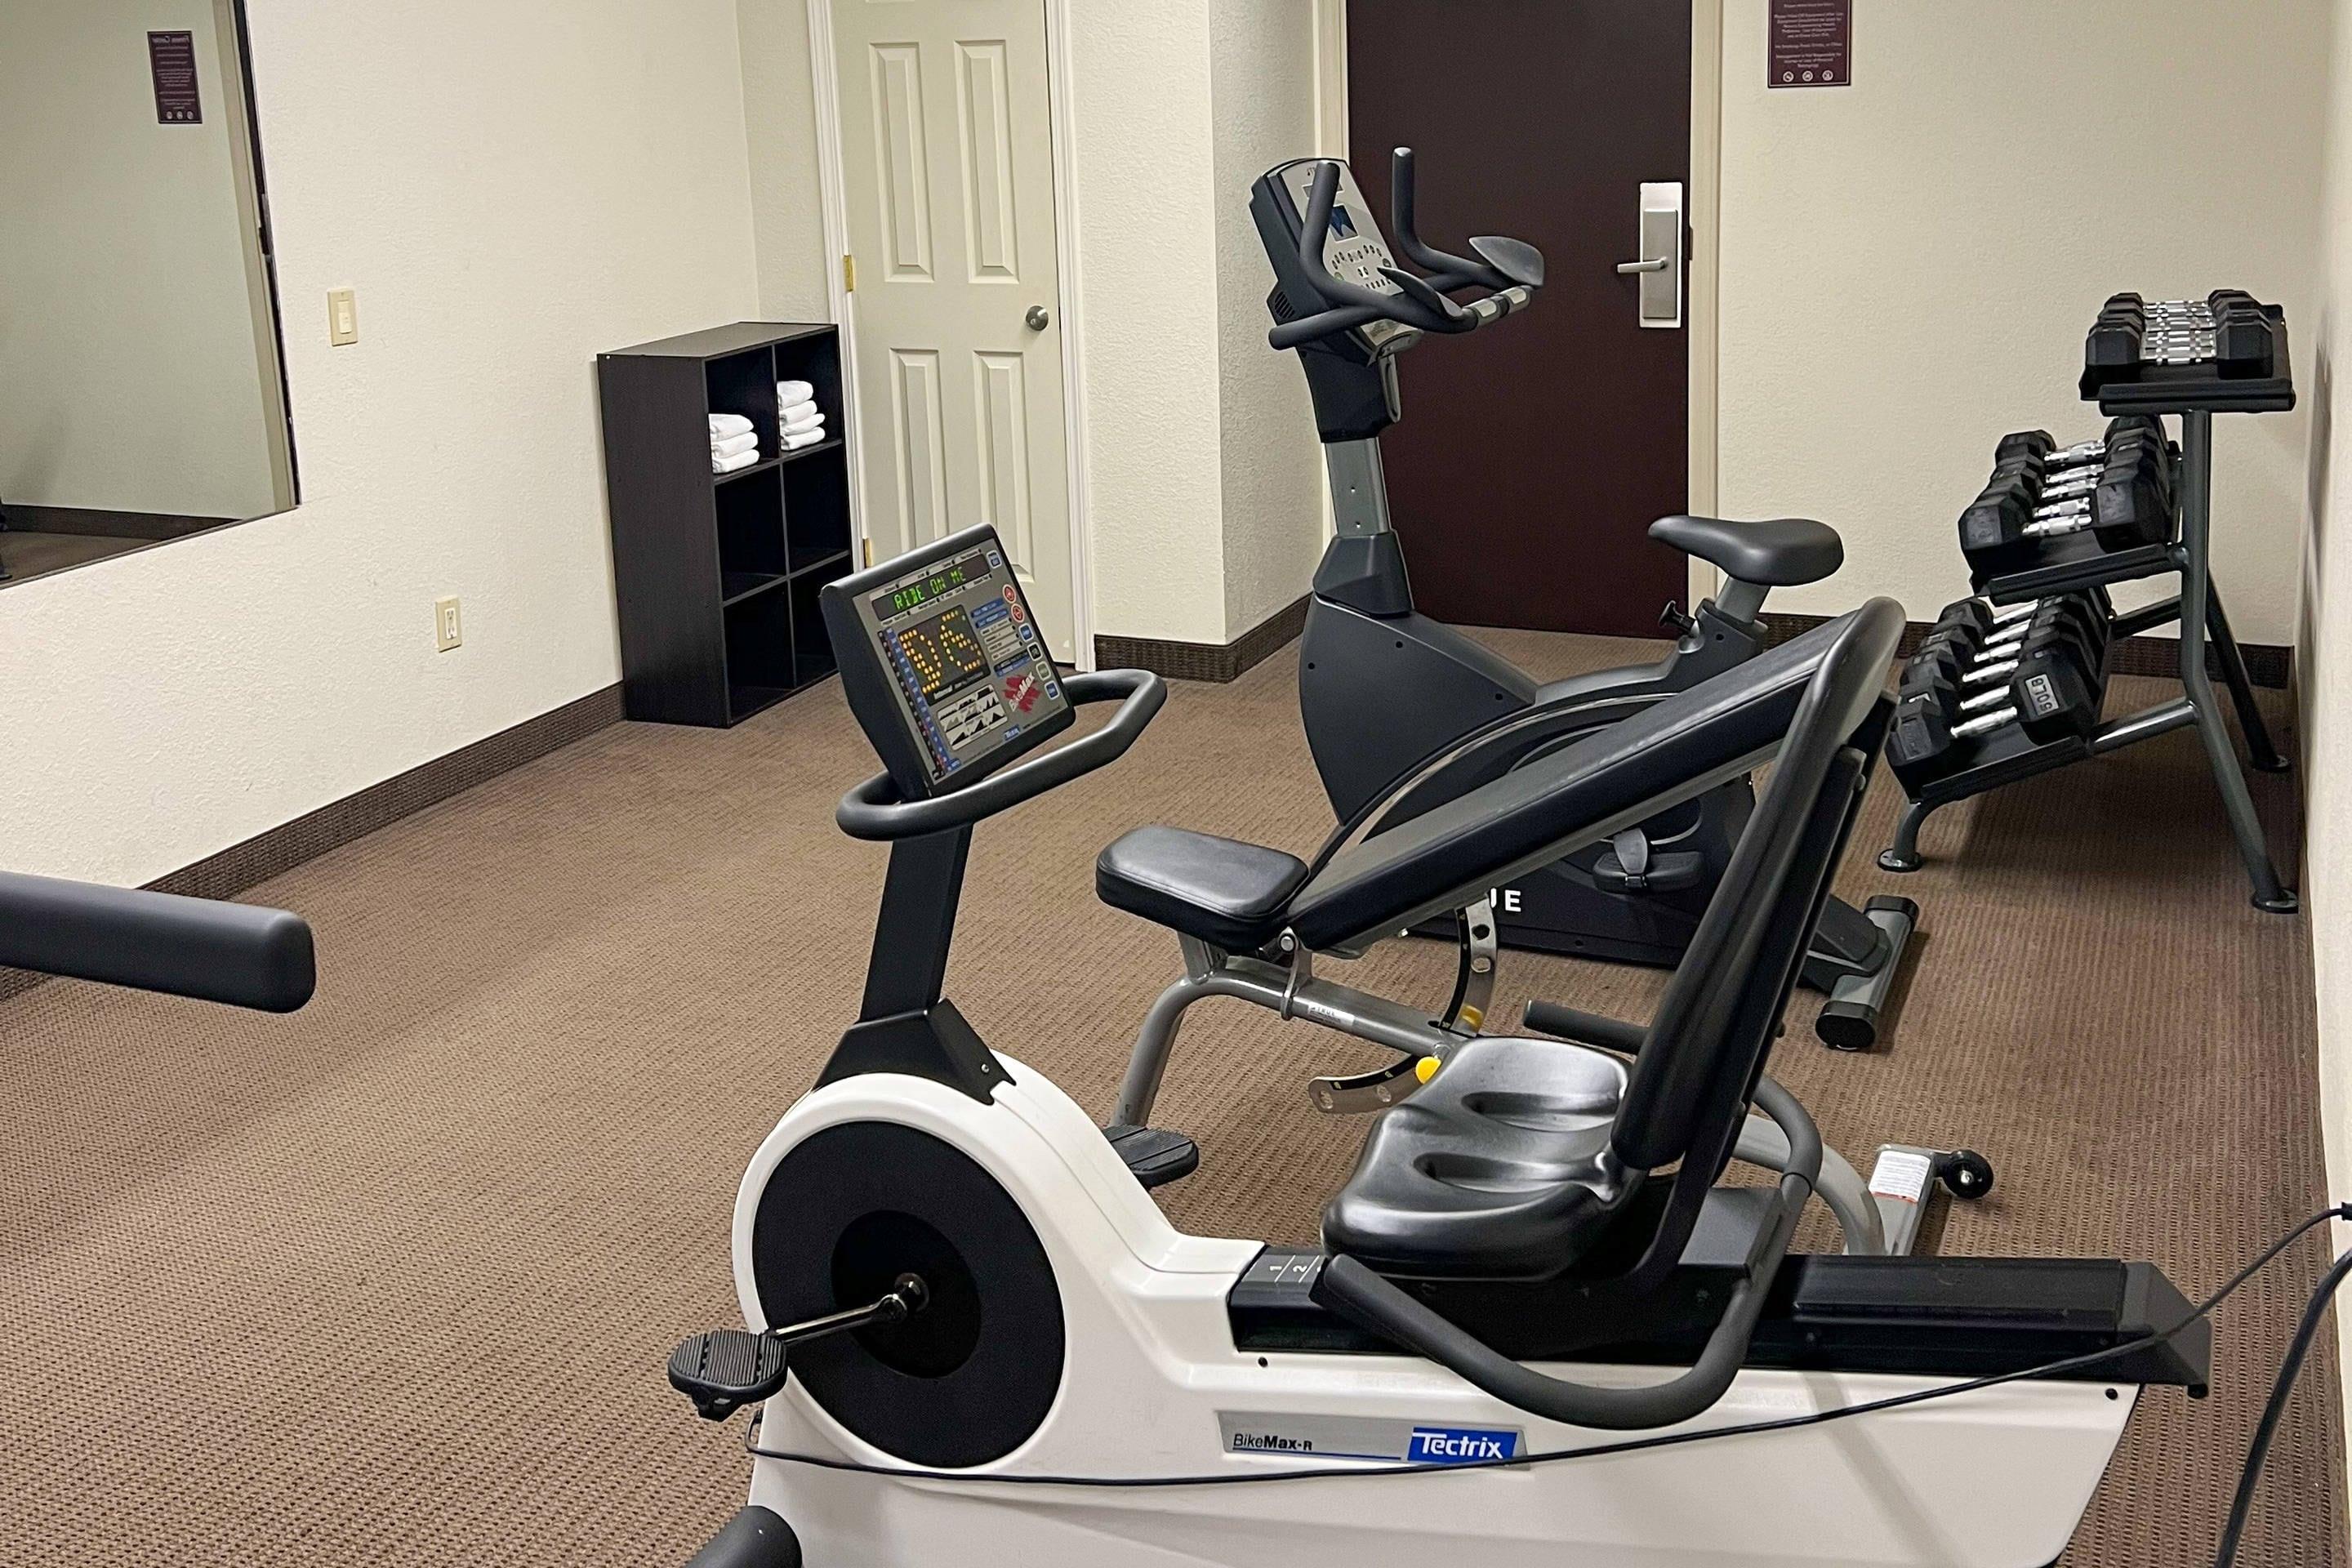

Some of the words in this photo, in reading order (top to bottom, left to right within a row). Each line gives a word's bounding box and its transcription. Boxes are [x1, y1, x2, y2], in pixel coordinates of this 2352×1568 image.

[893, 584, 925, 609] RIDE
[929, 577, 947, 595] ON
[950, 566, 966, 584] ME
[1009, 671, 1036, 712] BikeMax
[2031, 678, 2053, 711] 50LB
[1232, 1433, 1312, 1451] BikeMax-R
[1411, 1432, 1503, 1459] Tectrix
